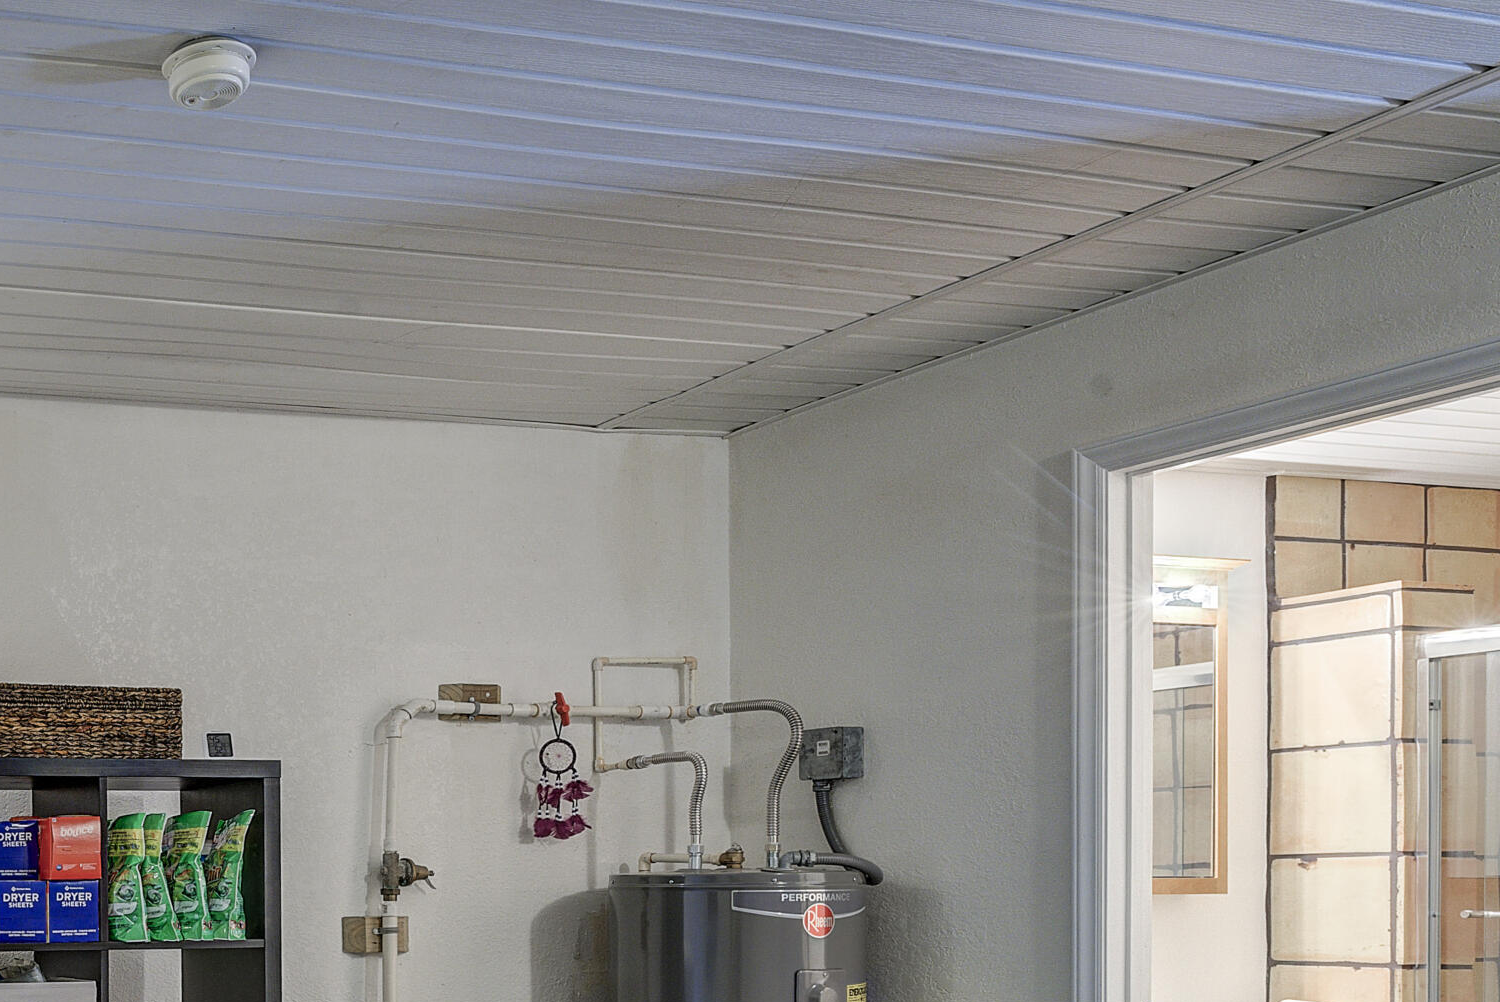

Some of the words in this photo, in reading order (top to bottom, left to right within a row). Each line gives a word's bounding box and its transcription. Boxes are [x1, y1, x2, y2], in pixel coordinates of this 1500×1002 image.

[2, 893, 40, 902] DRYER
[56, 892, 93, 901] DRYER
[781, 893, 850, 902] PERFORMANCE
[807, 904, 833, 933] Rheem
